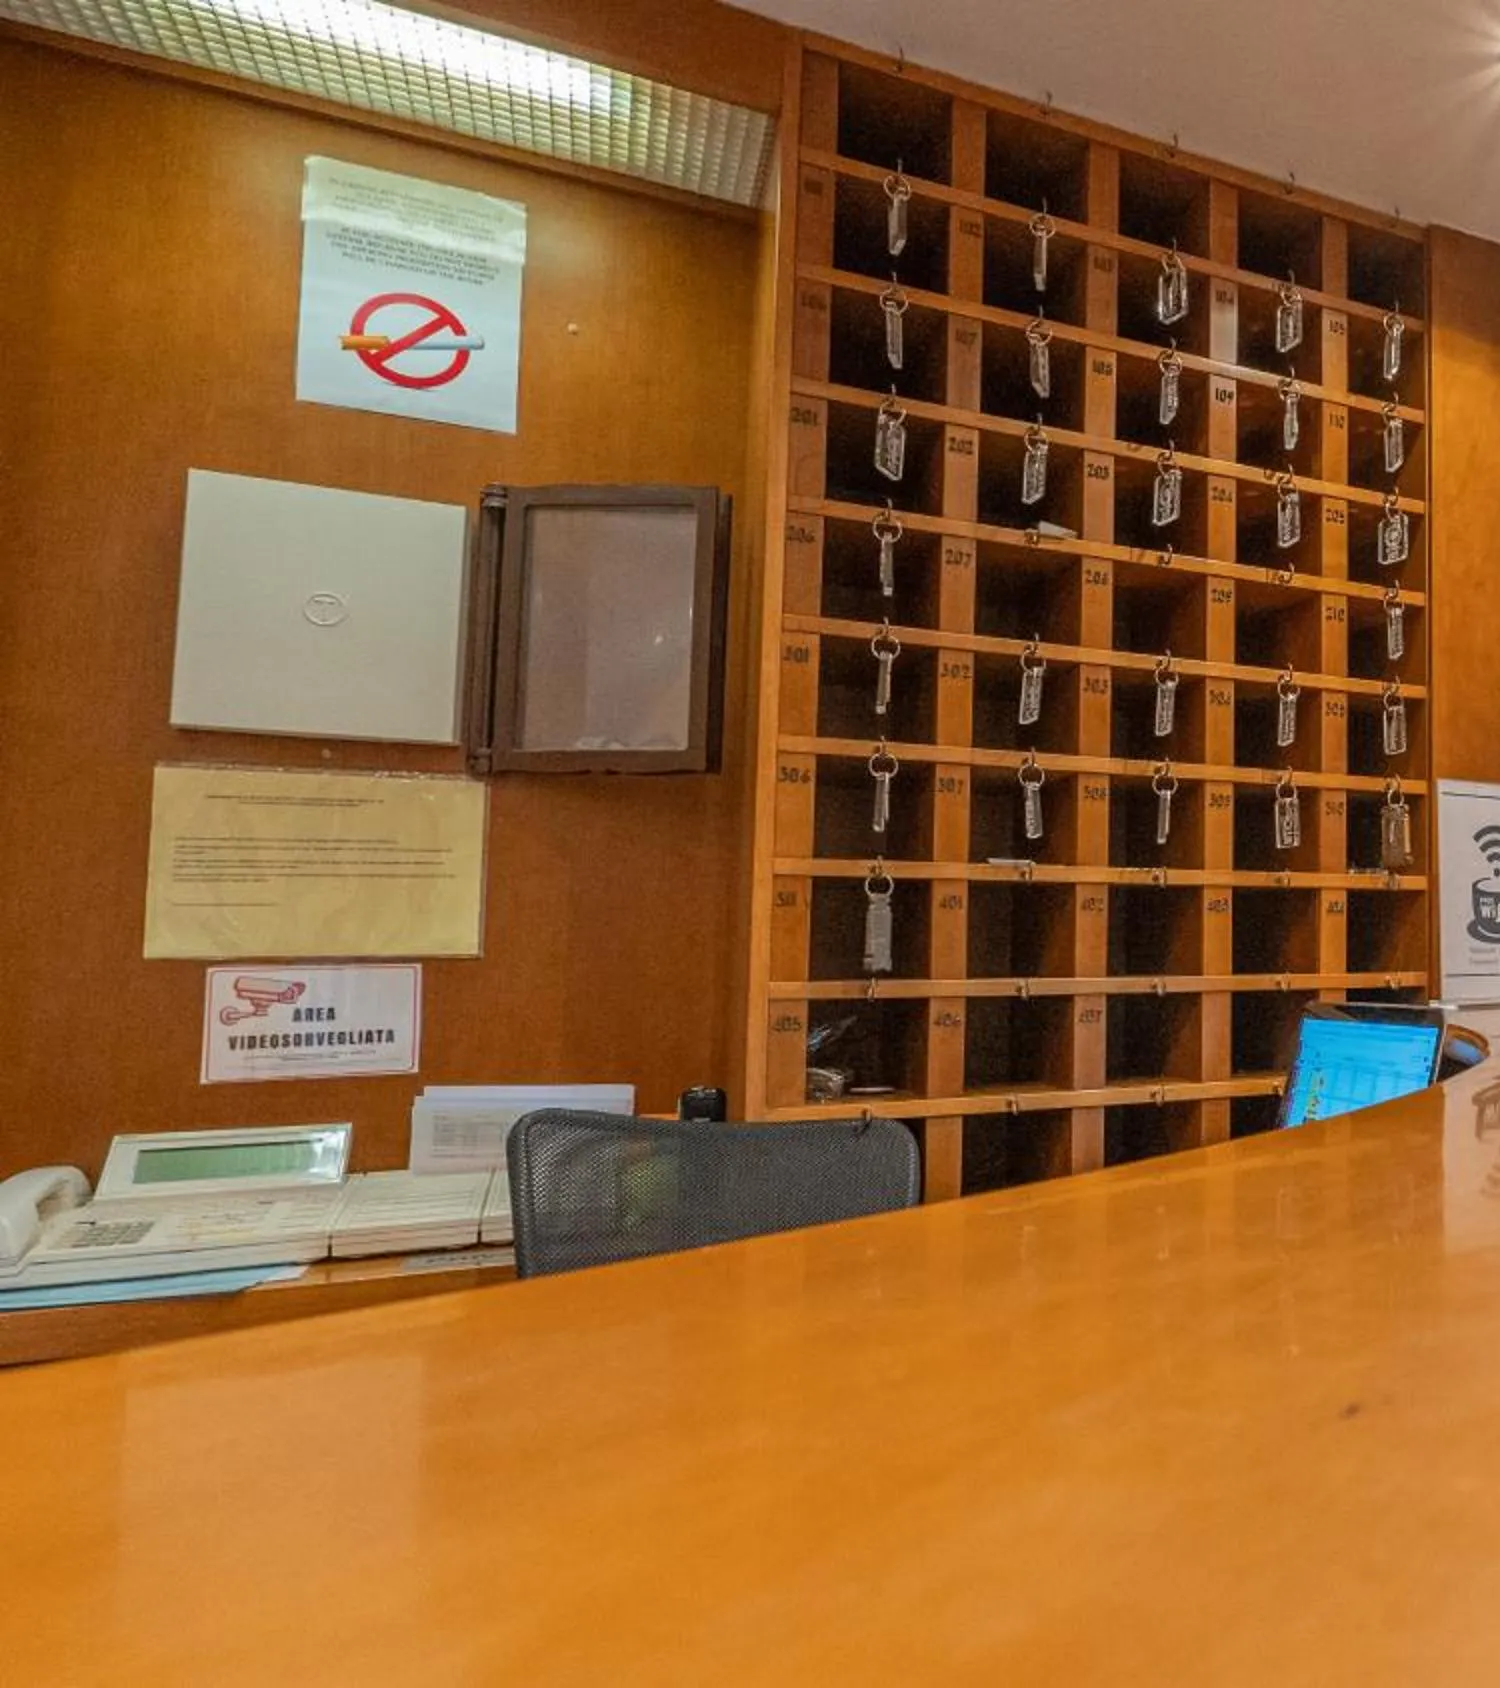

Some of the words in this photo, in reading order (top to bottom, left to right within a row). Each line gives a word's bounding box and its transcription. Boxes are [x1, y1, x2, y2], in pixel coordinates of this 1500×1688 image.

[1215, 388, 1233, 406] 109
[791, 407, 818, 424] 201
[948, 437, 974, 454] 202
[945, 549, 973, 567] 207
[1325, 607, 1344, 622] 210
[783, 646, 809, 663] 301
[941, 664, 971, 679] 302
[779, 766, 811, 783] 306
[938, 779, 964, 796] 307
[292, 1007, 336, 1022] AREA
[228, 1029, 396, 1051] VIDEOSORVEGLIATA
